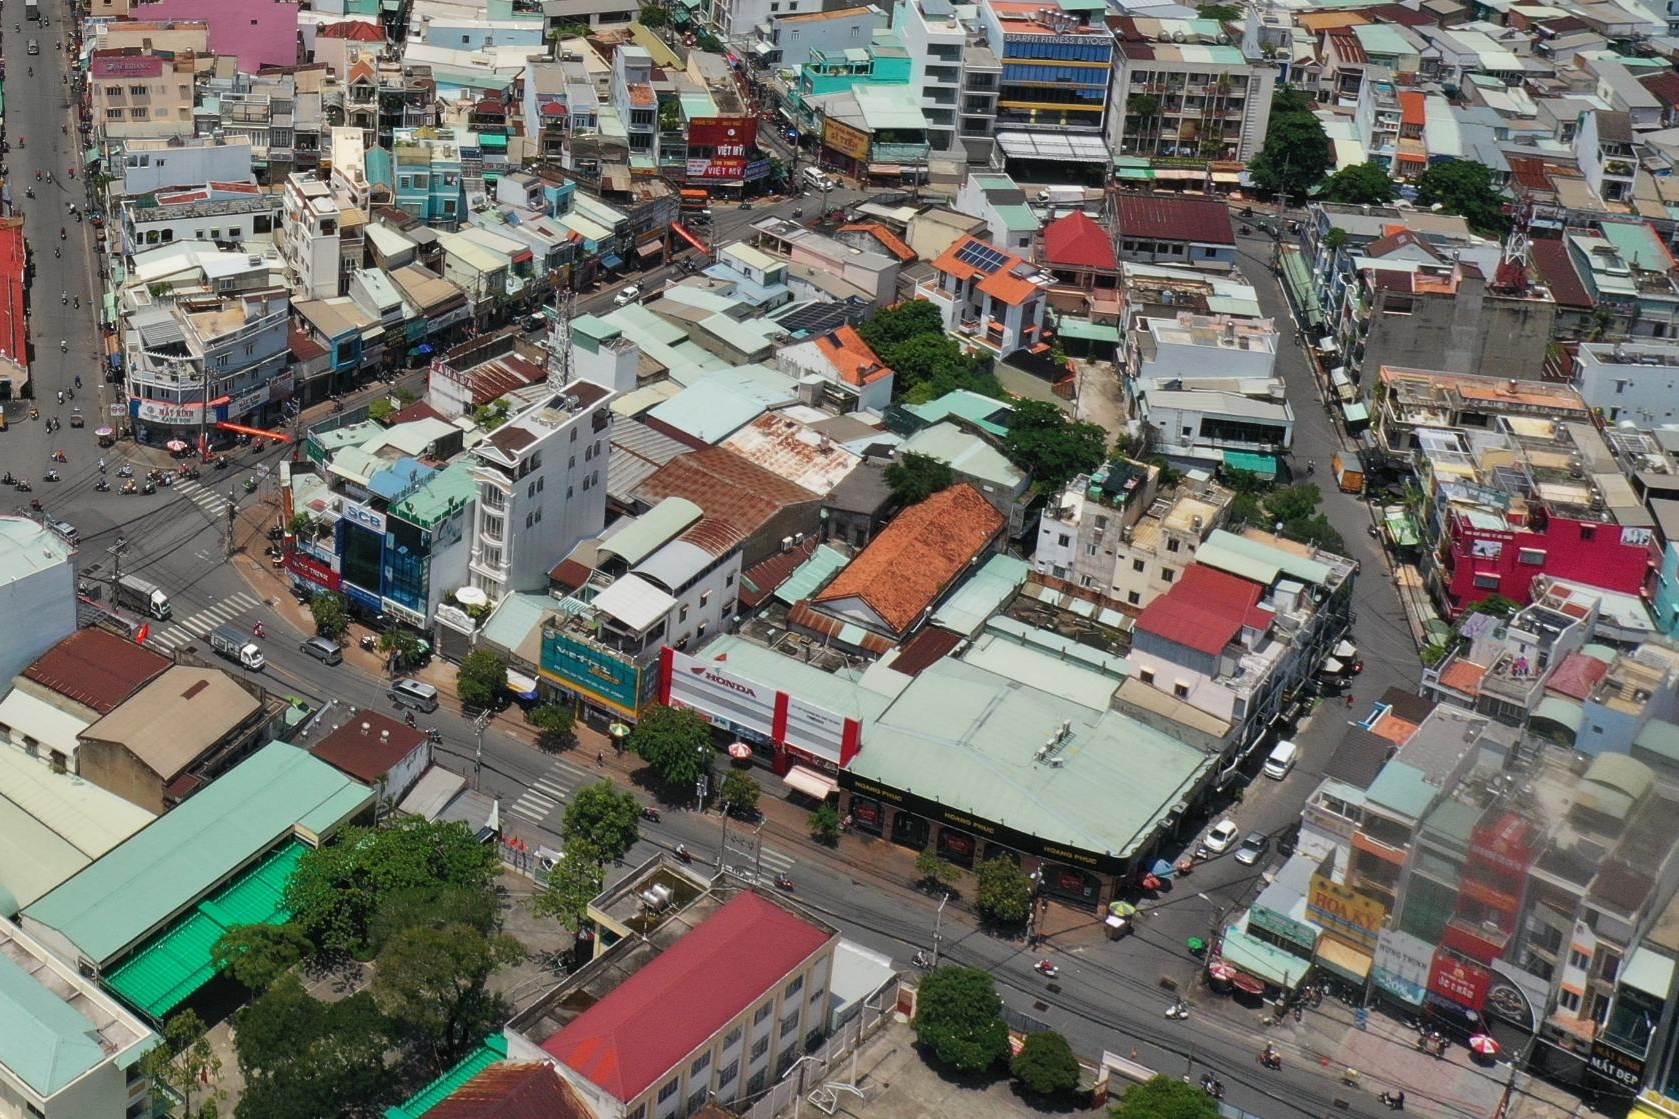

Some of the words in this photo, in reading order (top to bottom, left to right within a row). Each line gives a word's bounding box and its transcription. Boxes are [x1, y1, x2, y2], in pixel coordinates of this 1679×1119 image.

[1005, 34, 1039, 43] STARFIT
[1041, 35, 1075, 44] FITNESS
[1077, 37, 1084, 45] &
[1085, 37, 1112, 46] YOGA
[717, 144, 731, 157] VIỆT
[707, 167, 726, 176] VIỆT
[728, 166, 742, 175] MỸ
[431, 360, 474, 389] FAHASA
[347, 505, 381, 528] SCB
[705, 672, 757, 699] HONDA
[1314, 892, 1348, 921] HOA
[1591, 1056, 1615, 1076] MẮT
